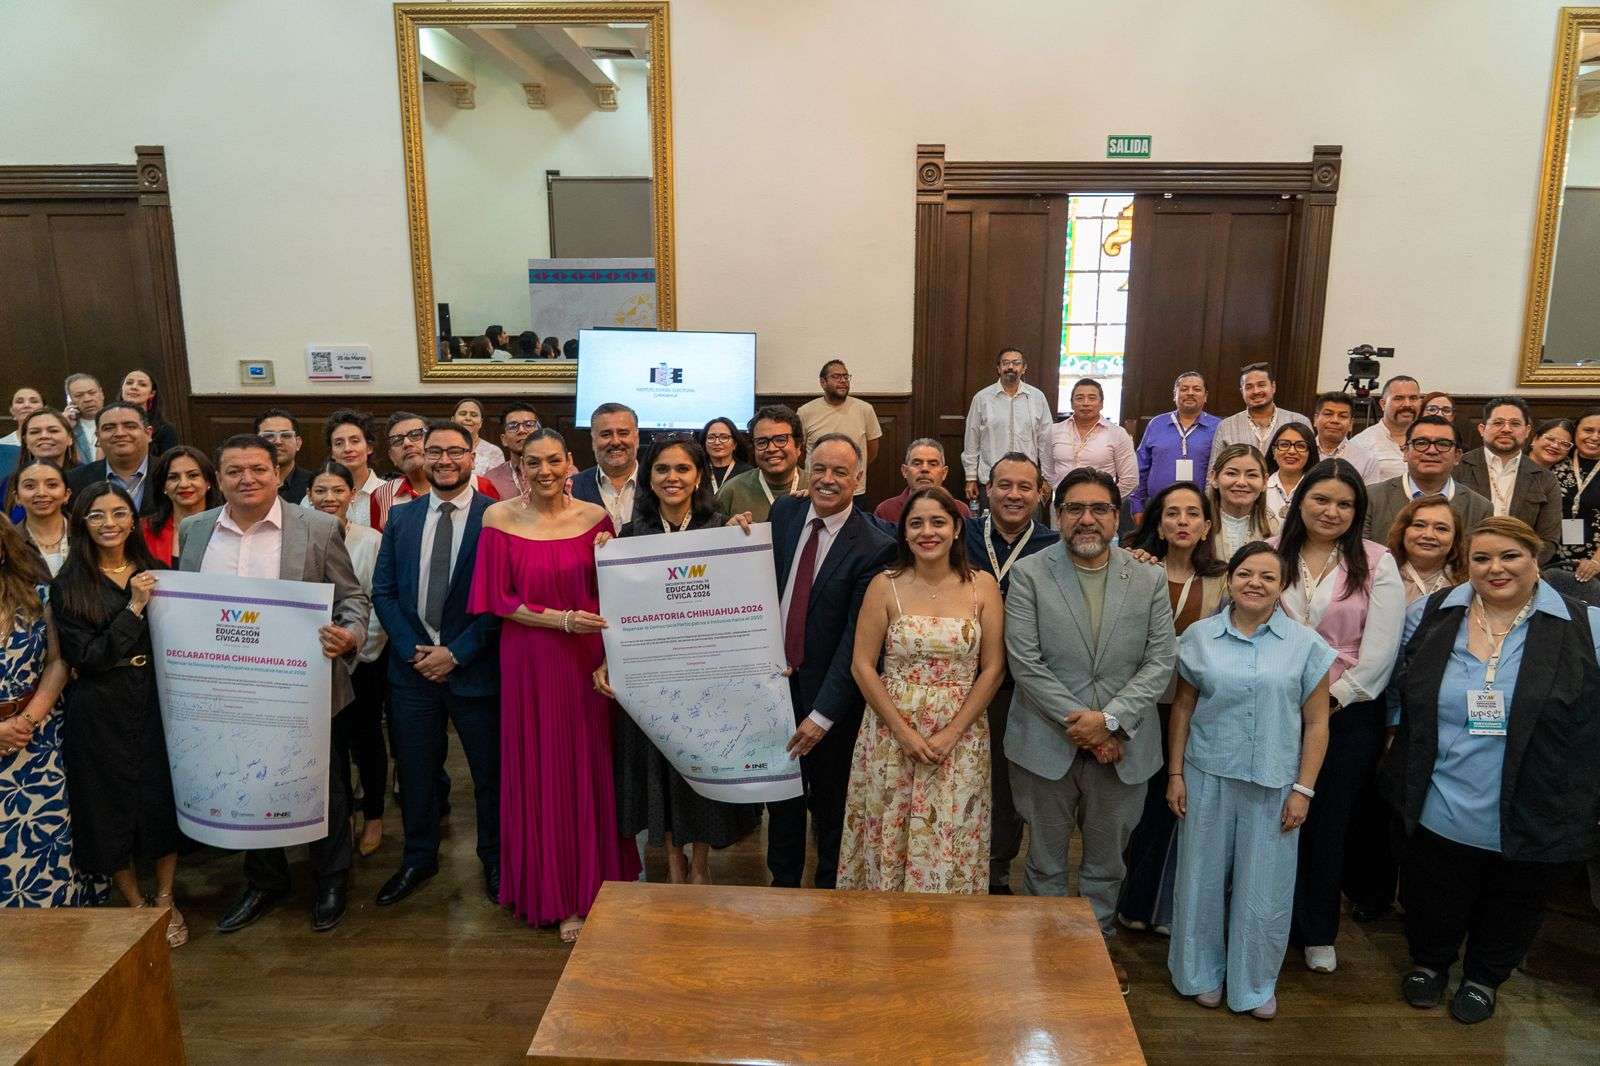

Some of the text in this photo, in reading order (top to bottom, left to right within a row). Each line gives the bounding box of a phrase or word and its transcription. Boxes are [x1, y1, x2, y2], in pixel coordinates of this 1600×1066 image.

[1110, 139, 1149, 153] SALIDA
[693, 590, 711, 599] 2026
[620, 604, 763, 625] DECLARATORIA CHIHUAHUA 2026
[241, 636, 260, 645] 2026
[166, 649, 308, 668] DECLARATORIA CHIHUAHUA 2026
